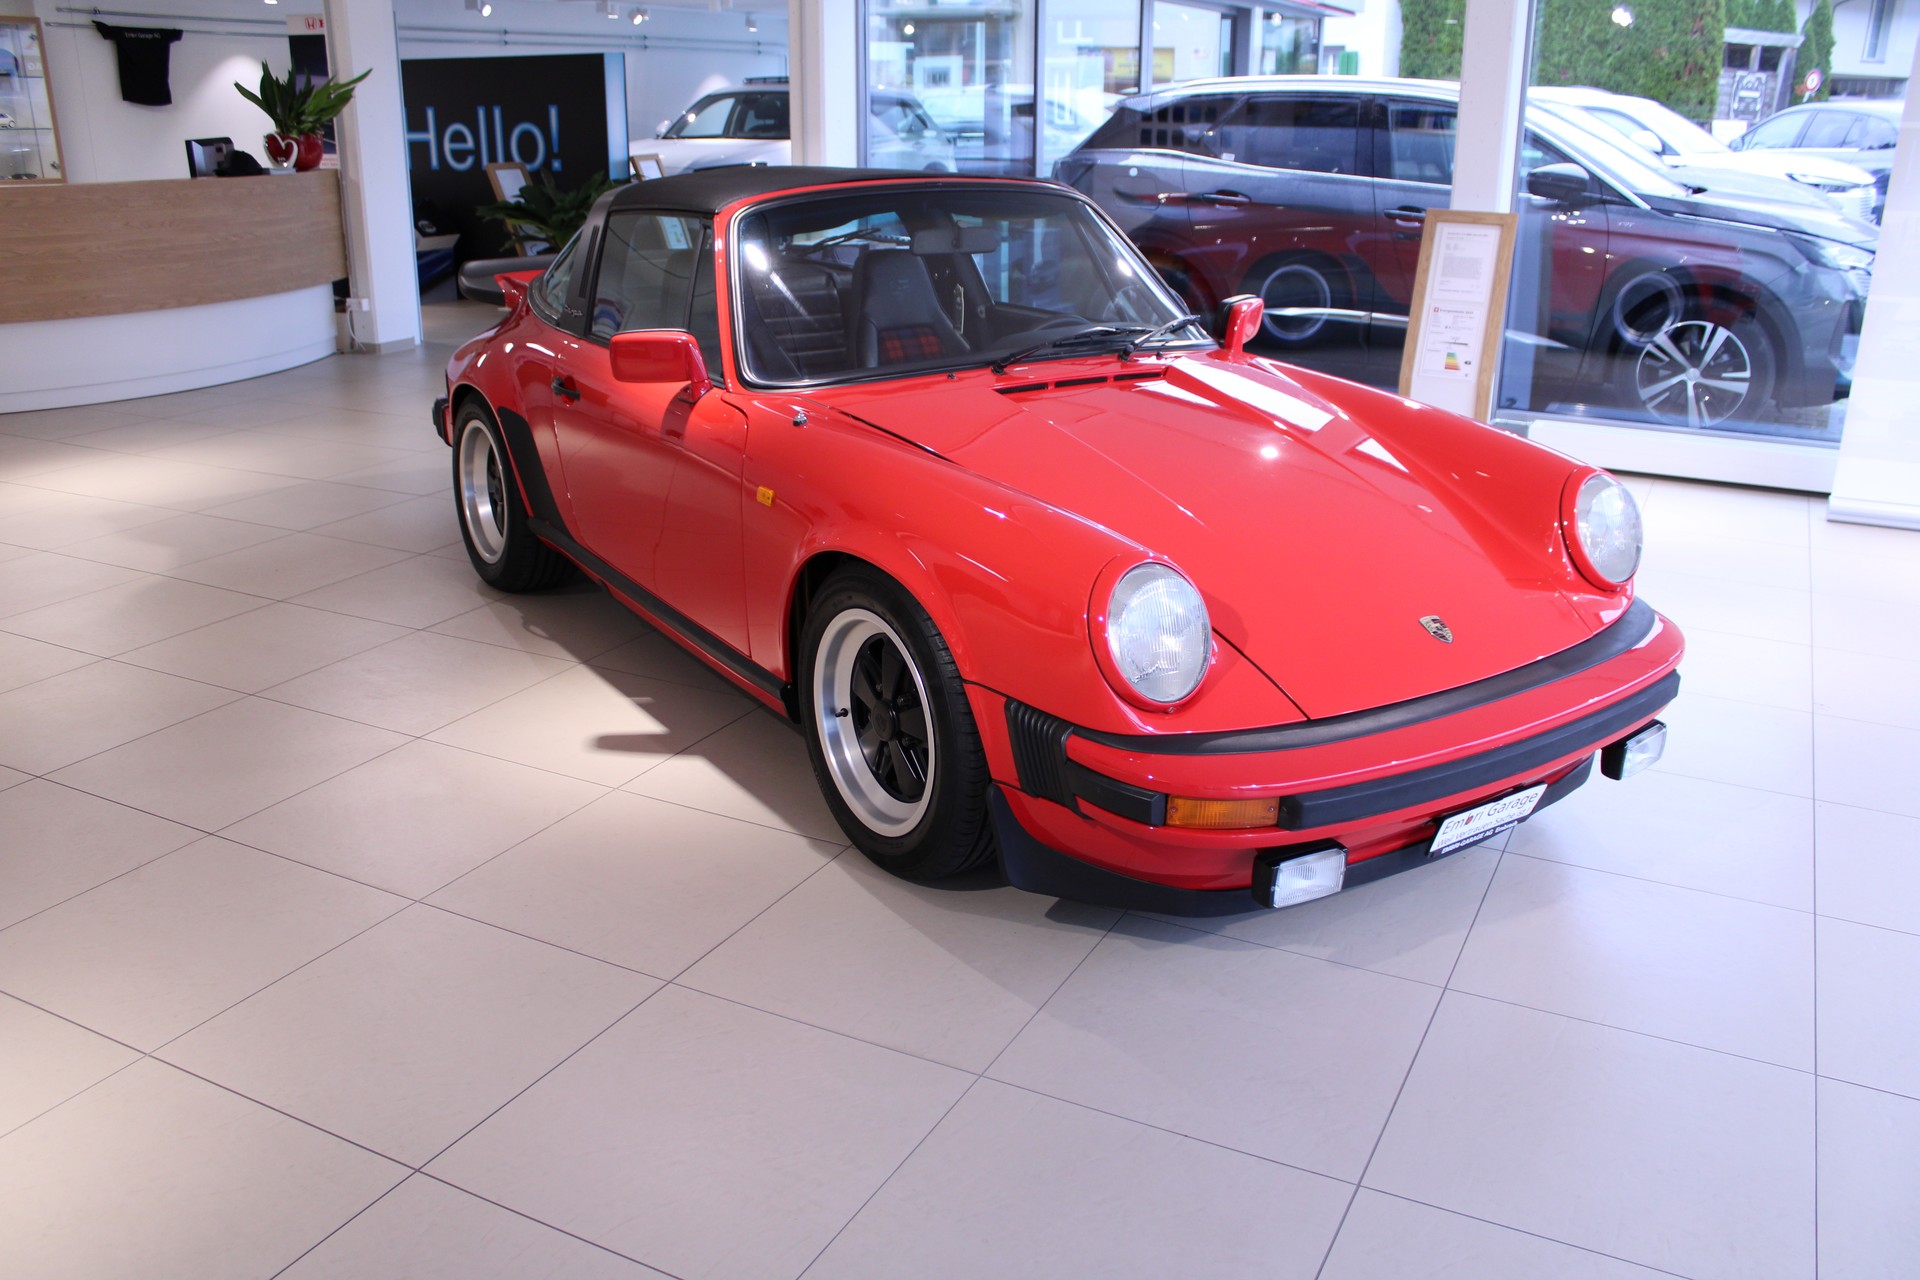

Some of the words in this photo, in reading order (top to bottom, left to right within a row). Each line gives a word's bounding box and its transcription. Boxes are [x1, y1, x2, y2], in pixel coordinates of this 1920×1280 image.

[403, 104, 562, 172] Hello!
[1442, 806, 1485, 835] Embri
[1487, 792, 1538, 817] Garage
[1455, 820, 1493, 841] Vertrauen
[1493, 812, 1517, 827] Sache
